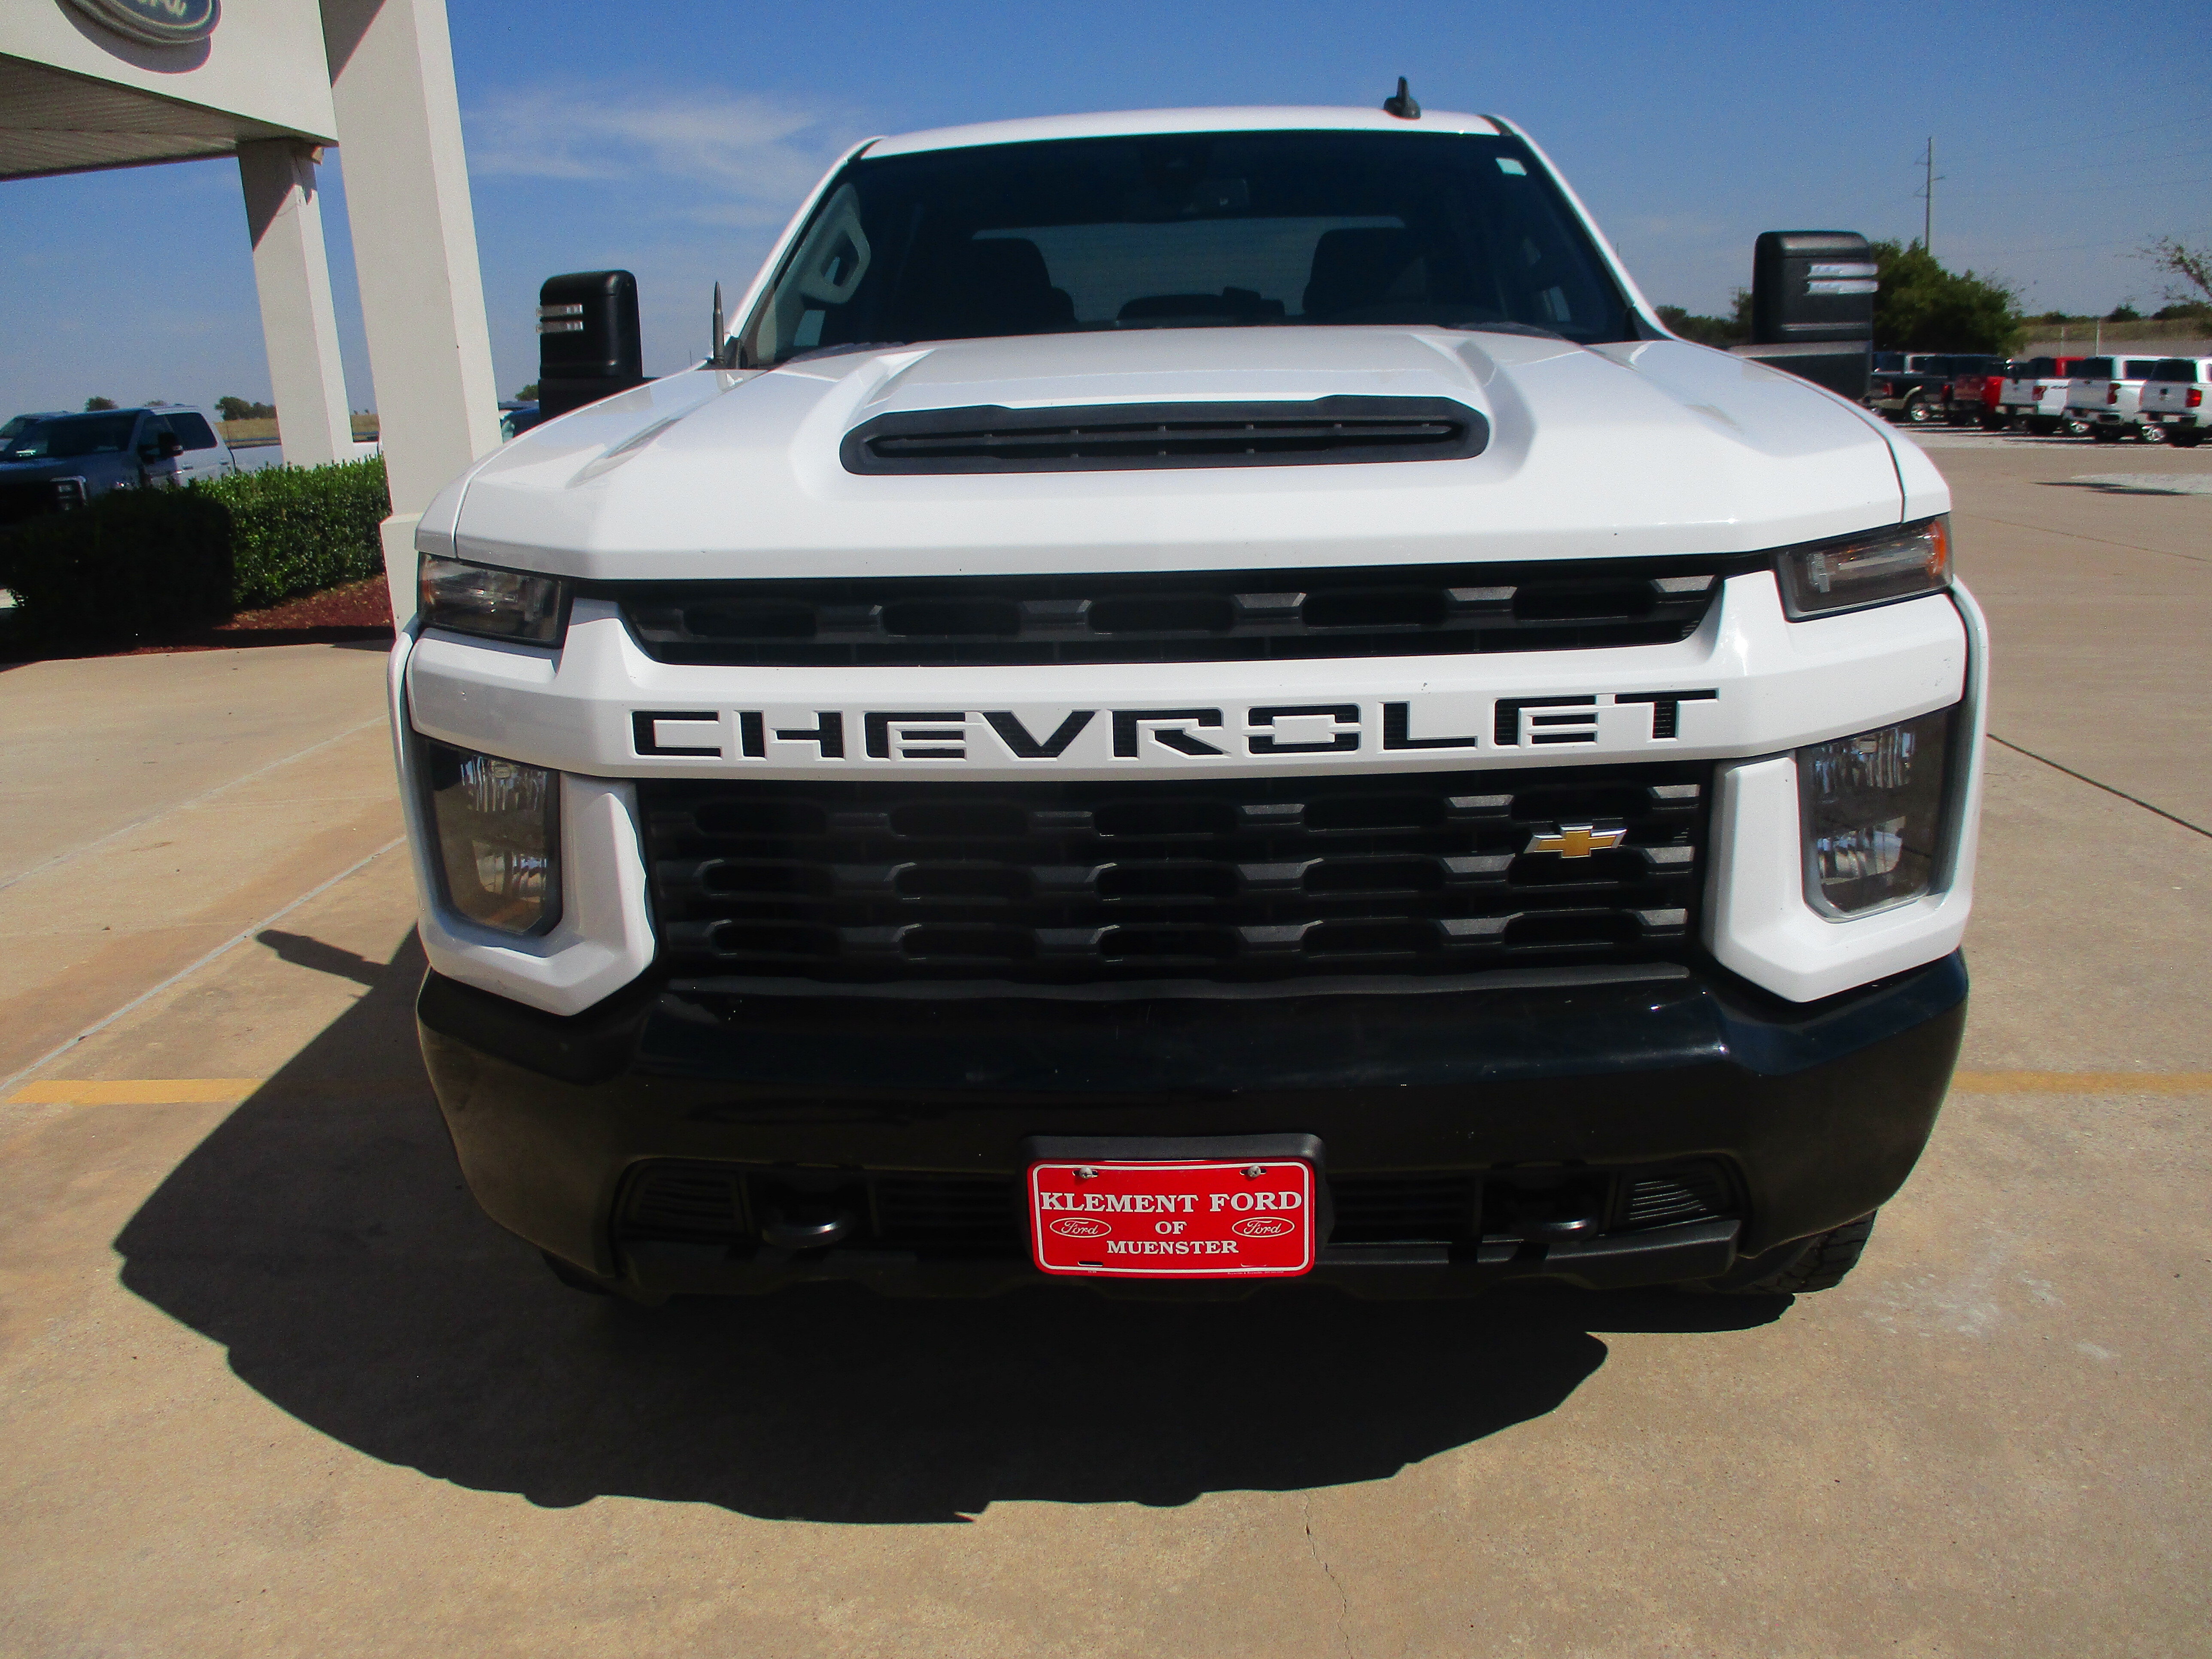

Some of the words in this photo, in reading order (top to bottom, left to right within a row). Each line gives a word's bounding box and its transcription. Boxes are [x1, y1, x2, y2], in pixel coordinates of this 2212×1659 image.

[631, 688, 1718, 758] CHEVROLET
[1040, 1192, 1199, 1212] KLEMENT
[1209, 1191, 1302, 1212] FORD
[1061, 1220, 1099, 1235] Ford
[1155, 1221, 1188, 1234] OF
[1243, 1220, 1282, 1234] Ford
[1106, 1240, 1239, 1255] MUENSTER
